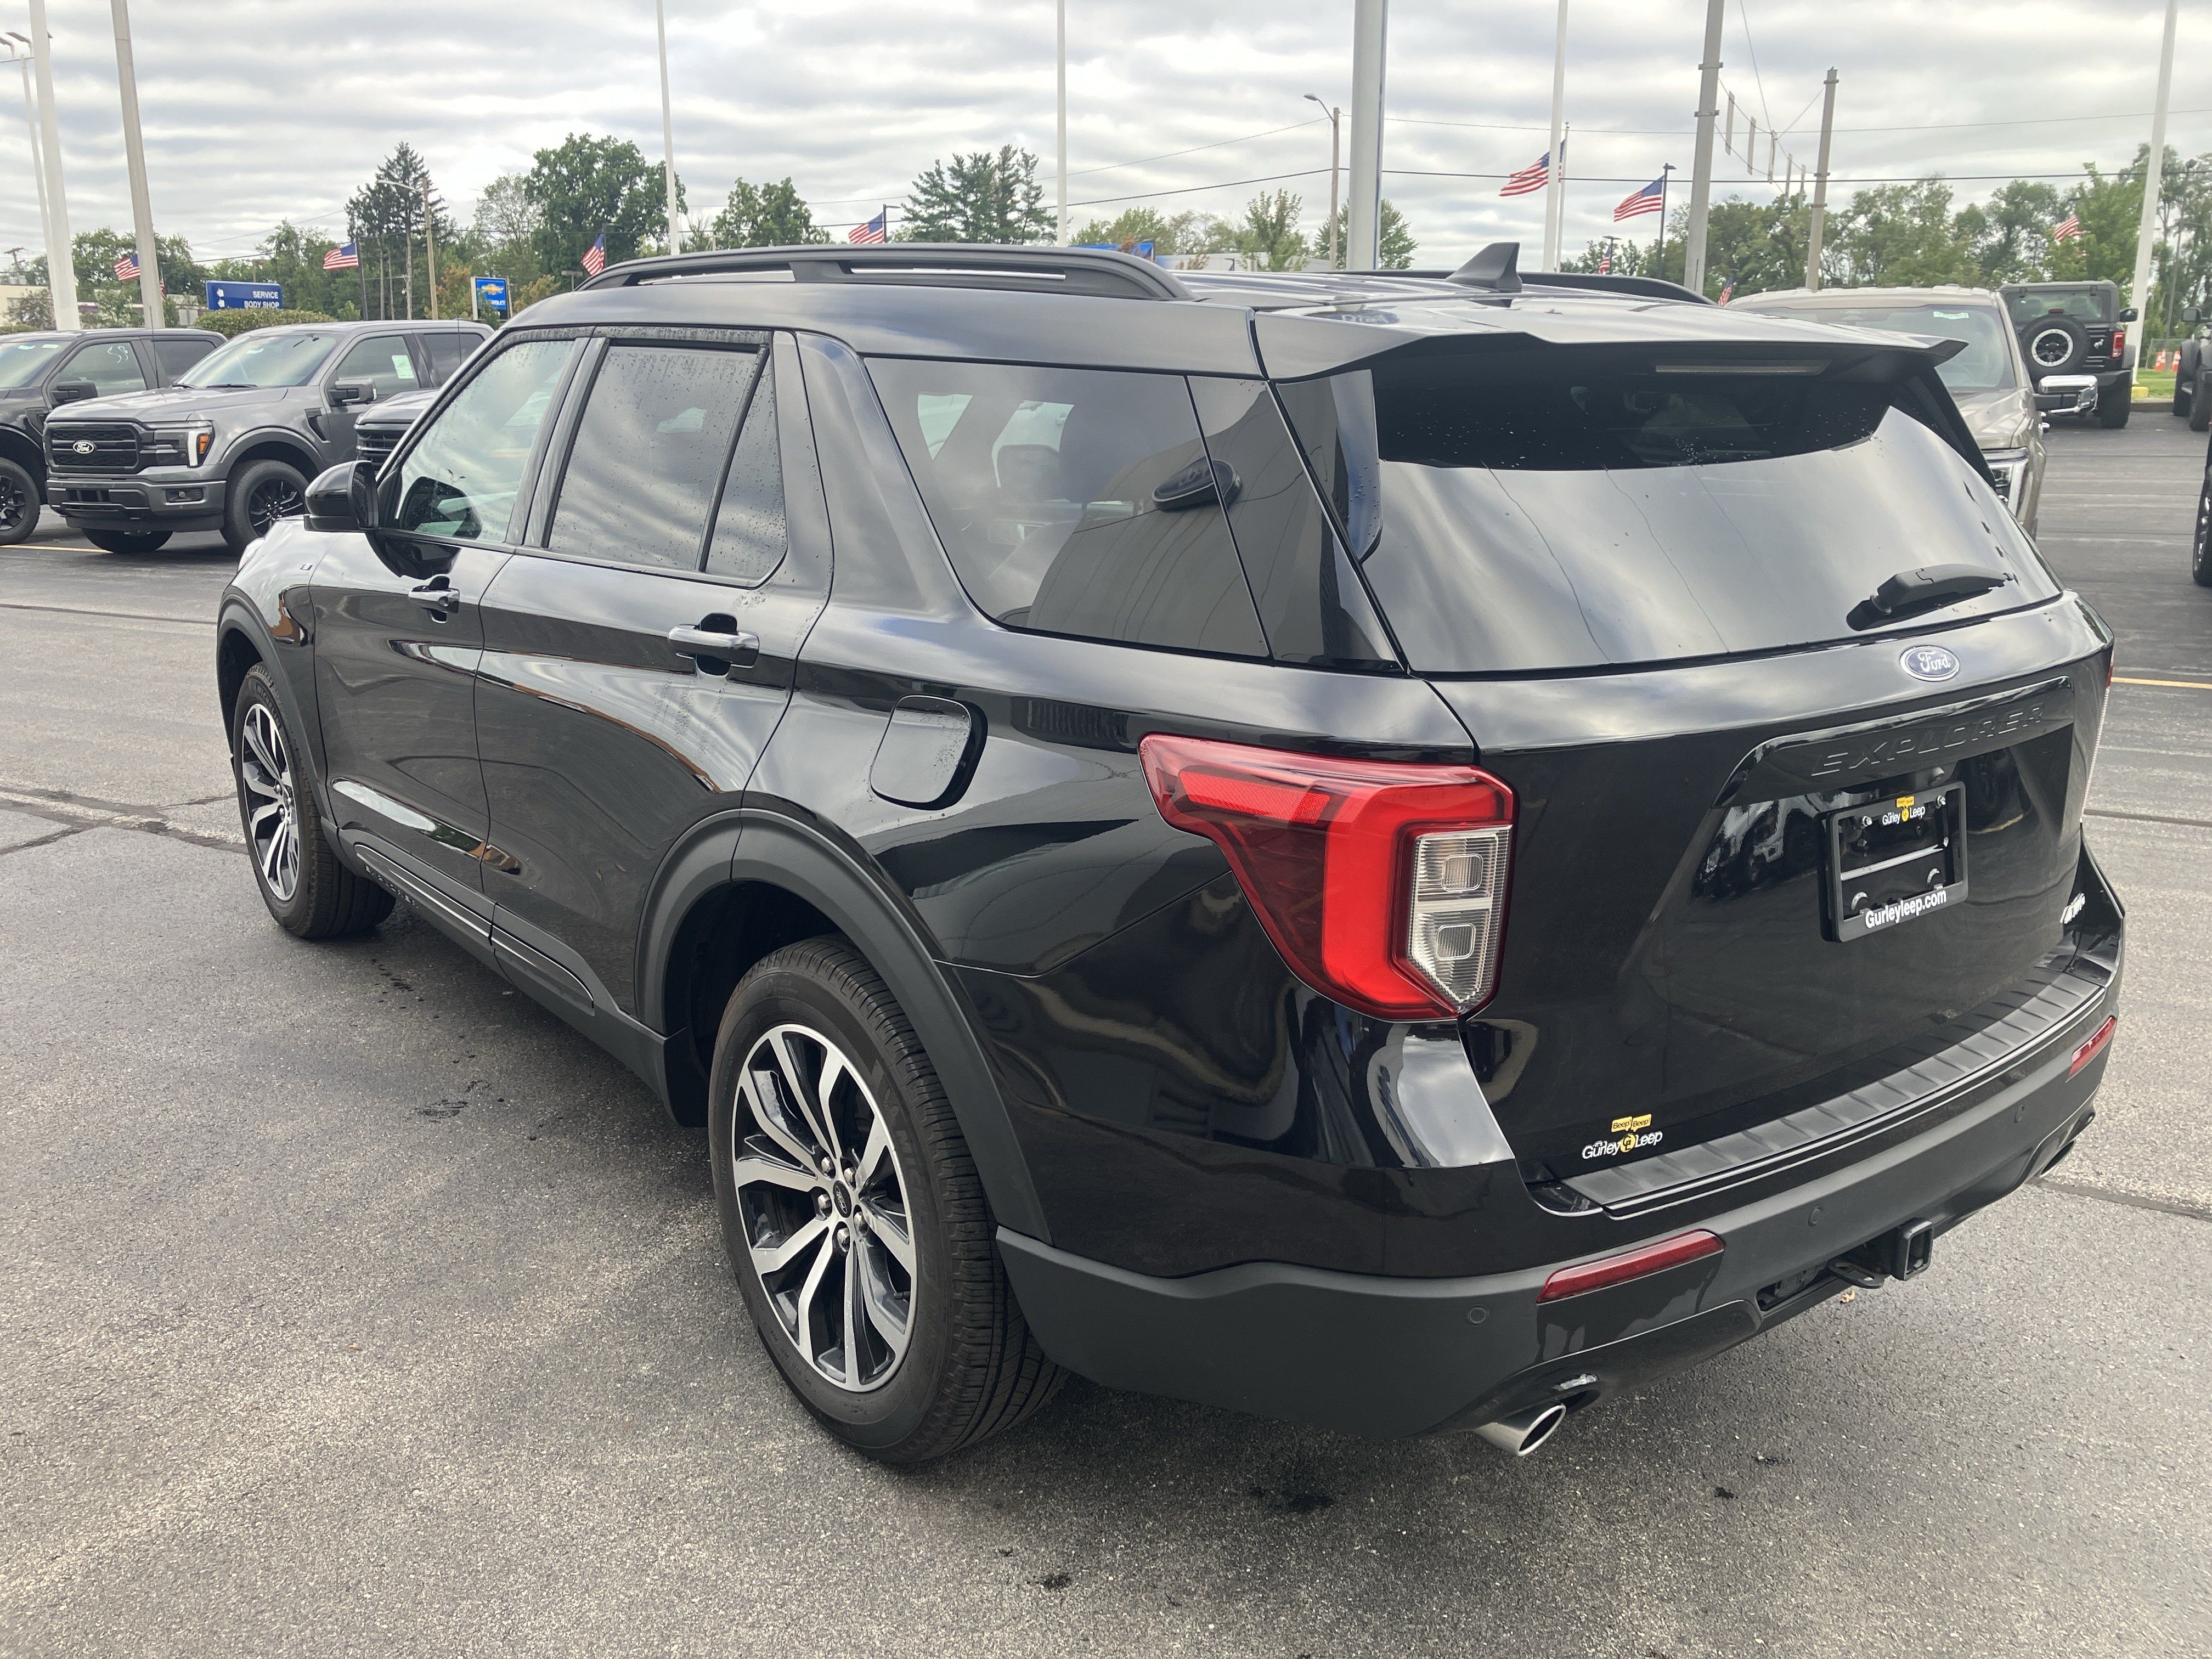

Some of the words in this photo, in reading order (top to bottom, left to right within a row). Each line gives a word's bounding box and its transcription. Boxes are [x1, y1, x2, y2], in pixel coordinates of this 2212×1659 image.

[244, 300, 261, 308] BODY
[1917, 651, 1951, 672] Ford
[1811, 703, 2045, 777] EXPLORER
[1882, 812, 1901, 825] Gurley
[1910, 806, 1926, 819] Leep
[1865, 890, 1947, 928] Gurleyleep.com
[1613, 1119, 1632, 1129] Beep!
[1633, 1117, 1651, 1127] Beep!
[1582, 1141, 1622, 1159] Gurley
[1635, 1131, 1663, 1148] Leep
